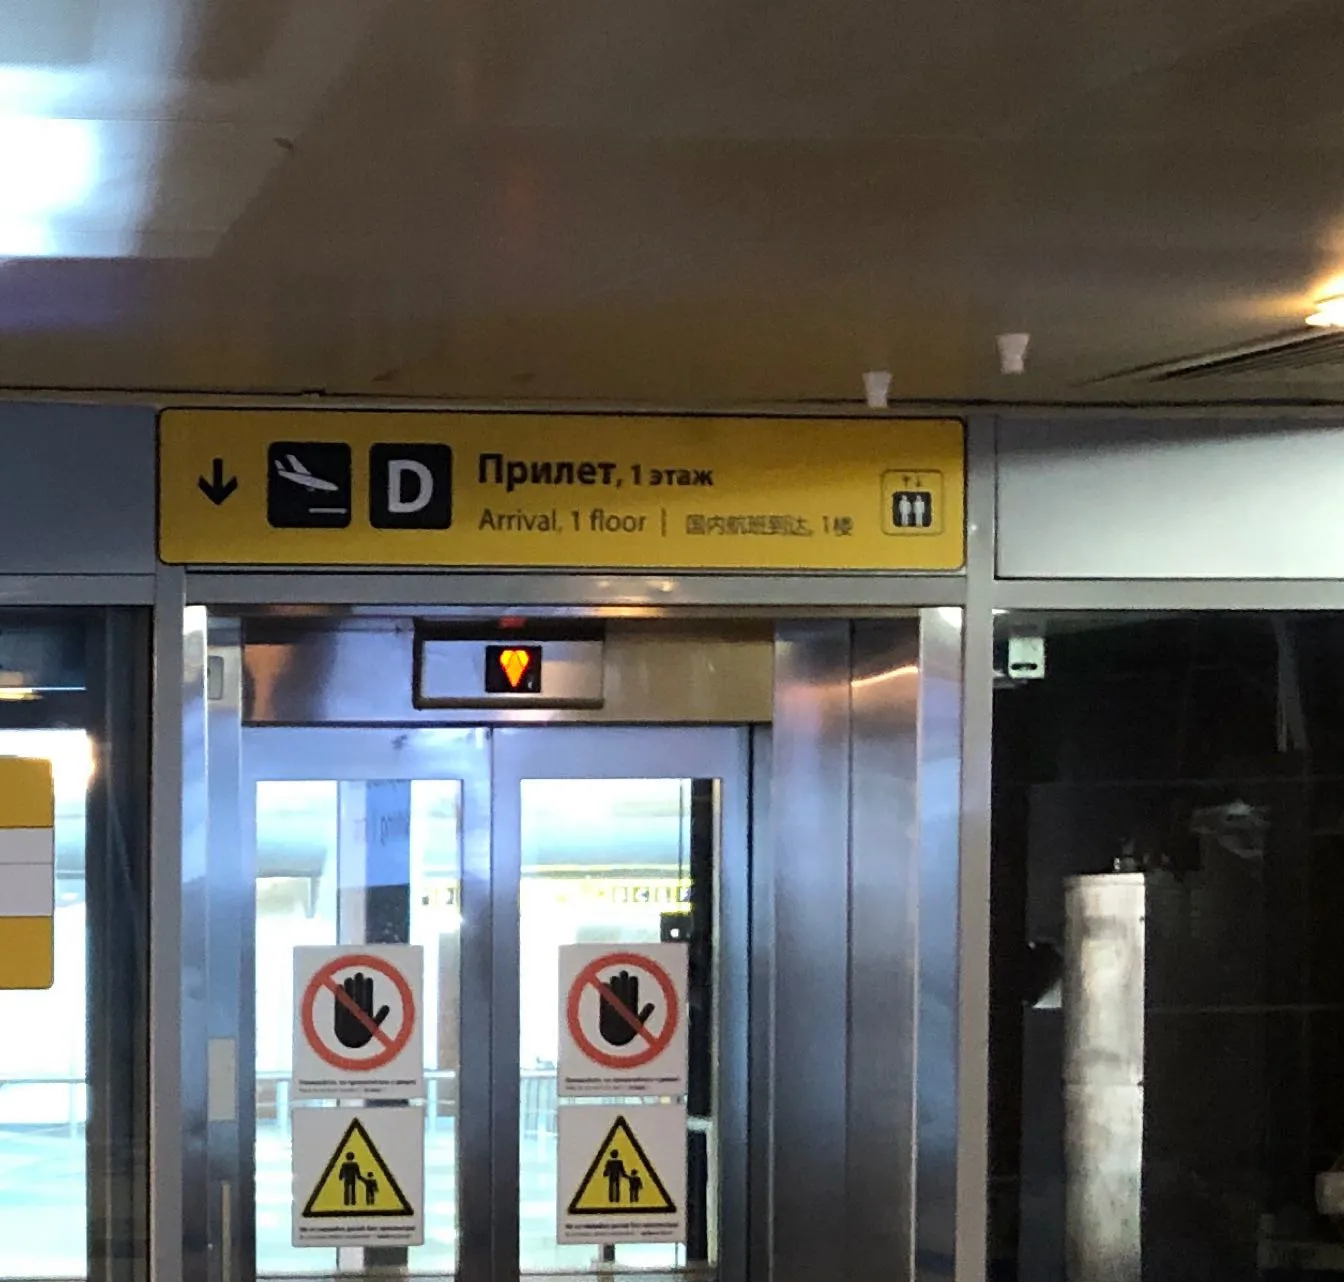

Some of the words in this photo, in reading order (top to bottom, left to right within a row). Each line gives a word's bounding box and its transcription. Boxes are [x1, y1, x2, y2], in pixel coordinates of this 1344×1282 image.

[387, 459, 434, 513] D
[478, 452, 622, 493] Прилет,
[630, 463, 642, 486] 1
[649, 468, 714, 486] этаж
[478, 507, 563, 534] Arrival,
[571, 509, 580, 532] 1
[589, 507, 647, 533] floor
